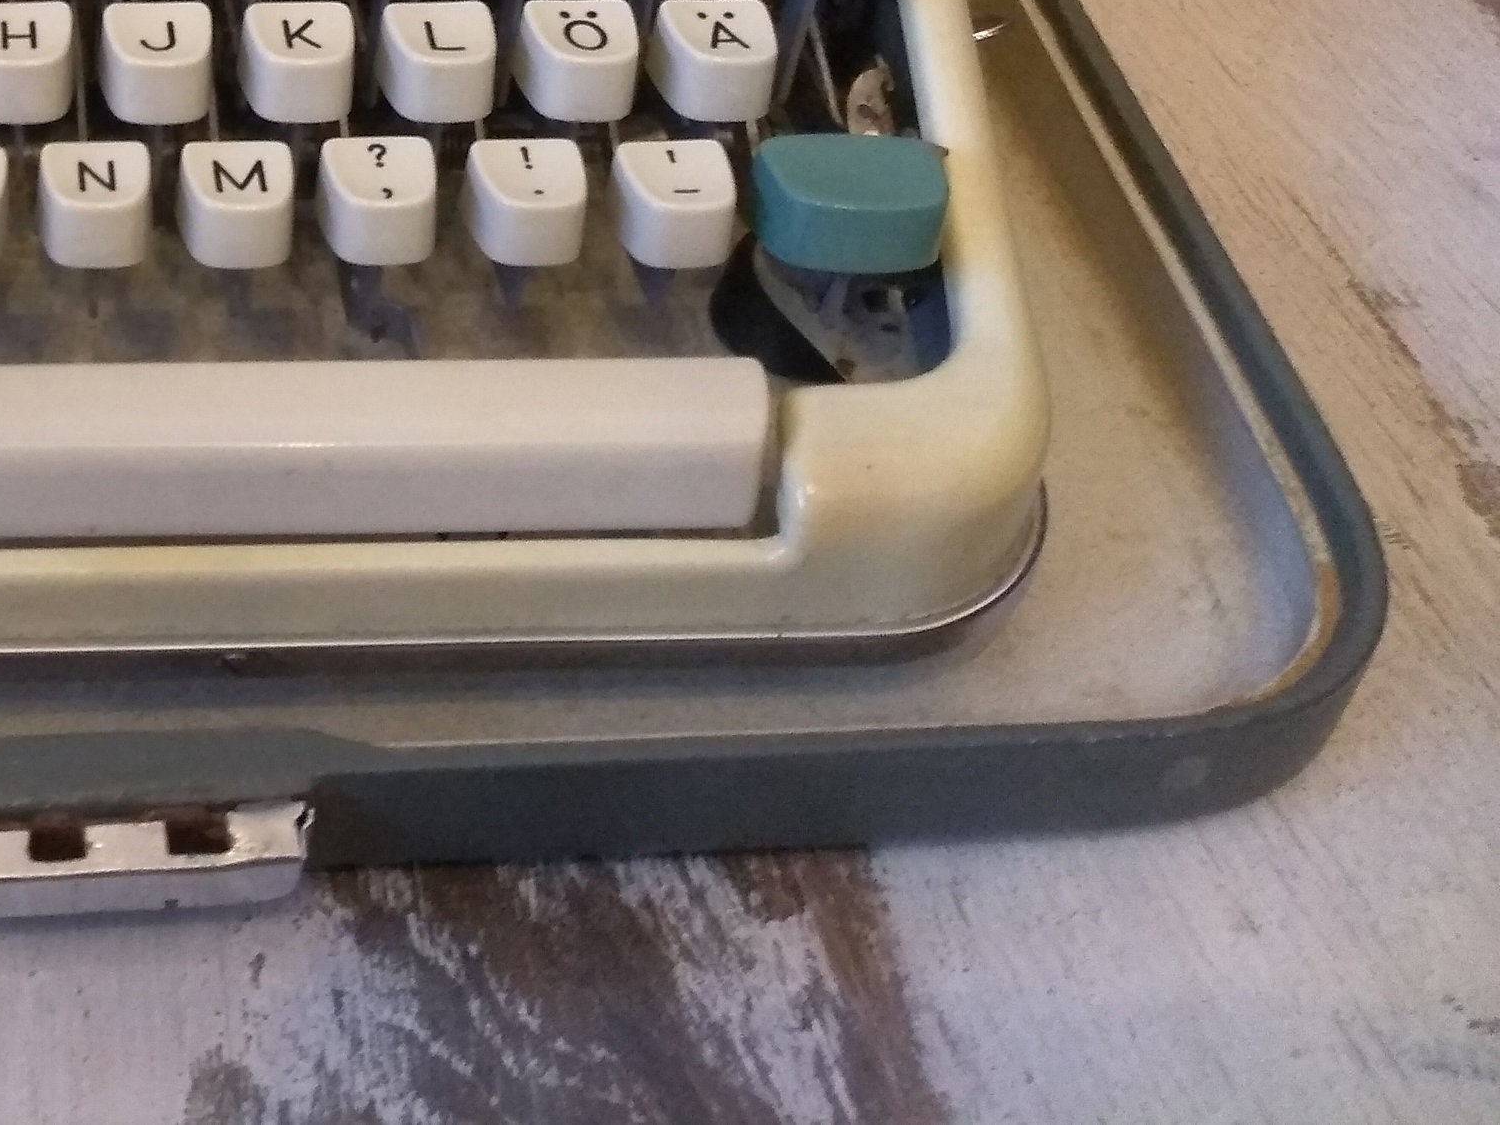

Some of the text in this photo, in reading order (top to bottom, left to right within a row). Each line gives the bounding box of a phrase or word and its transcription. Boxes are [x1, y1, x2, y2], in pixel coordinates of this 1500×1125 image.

[0, 20, 38, 50] H
[140, 20, 177, 52] J
[281, 18, 322, 50] K
[423, 20, 466, 52] L
[558, 10, 608, 51] Ö
[696, 11, 751, 50] Ä
[366, 143, 387, 168] ?
[520, 145, 533, 170] !
[77, 160, 117, 193] N
[212, 159, 269, 194] M
